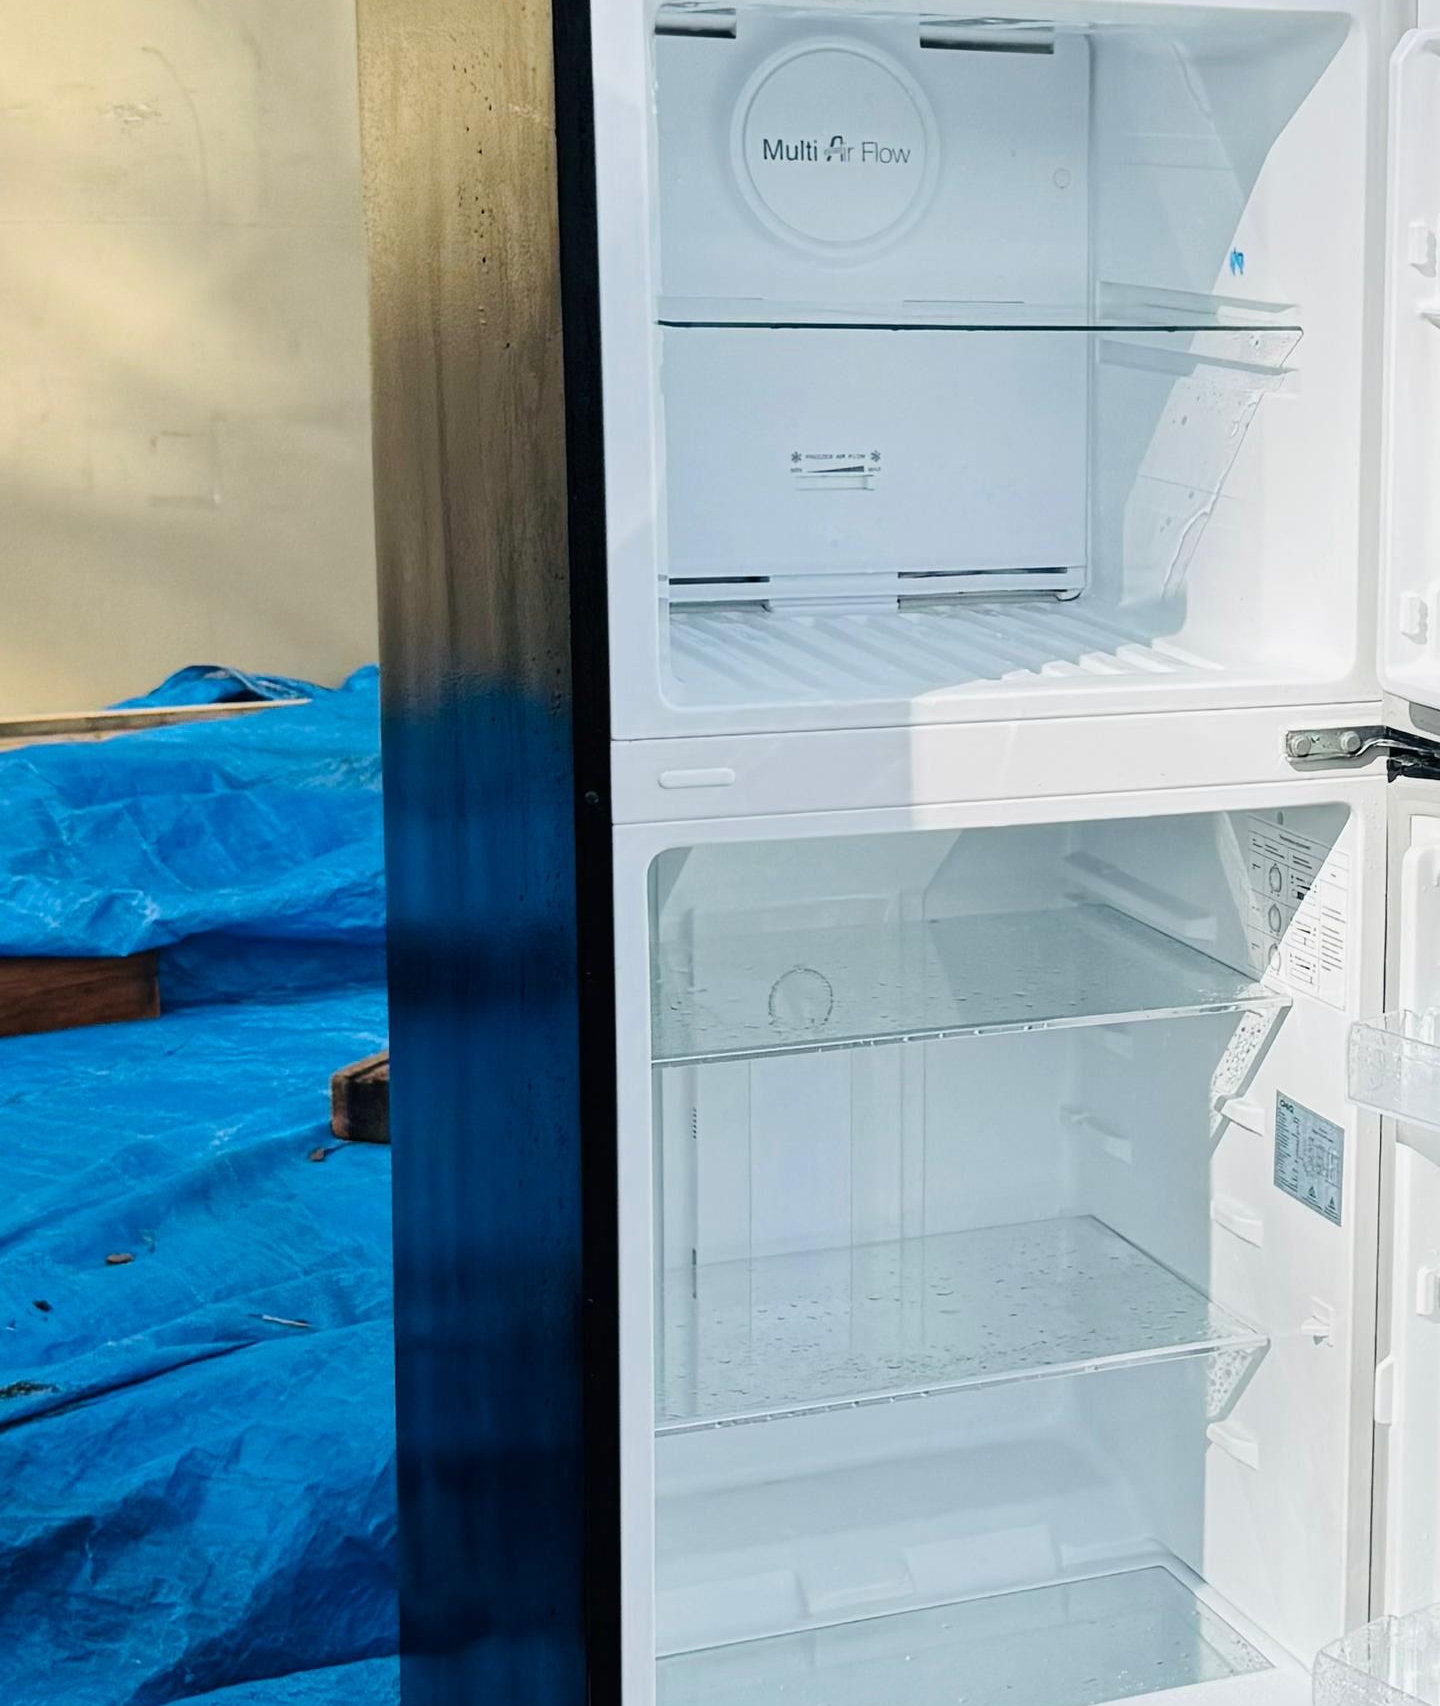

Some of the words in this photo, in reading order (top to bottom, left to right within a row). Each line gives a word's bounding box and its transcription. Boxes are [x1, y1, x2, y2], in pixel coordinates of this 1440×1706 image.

[763, 138, 818, 161] Multi
[824, 135, 853, 162] Air
[862, 141, 910, 164] Flow
